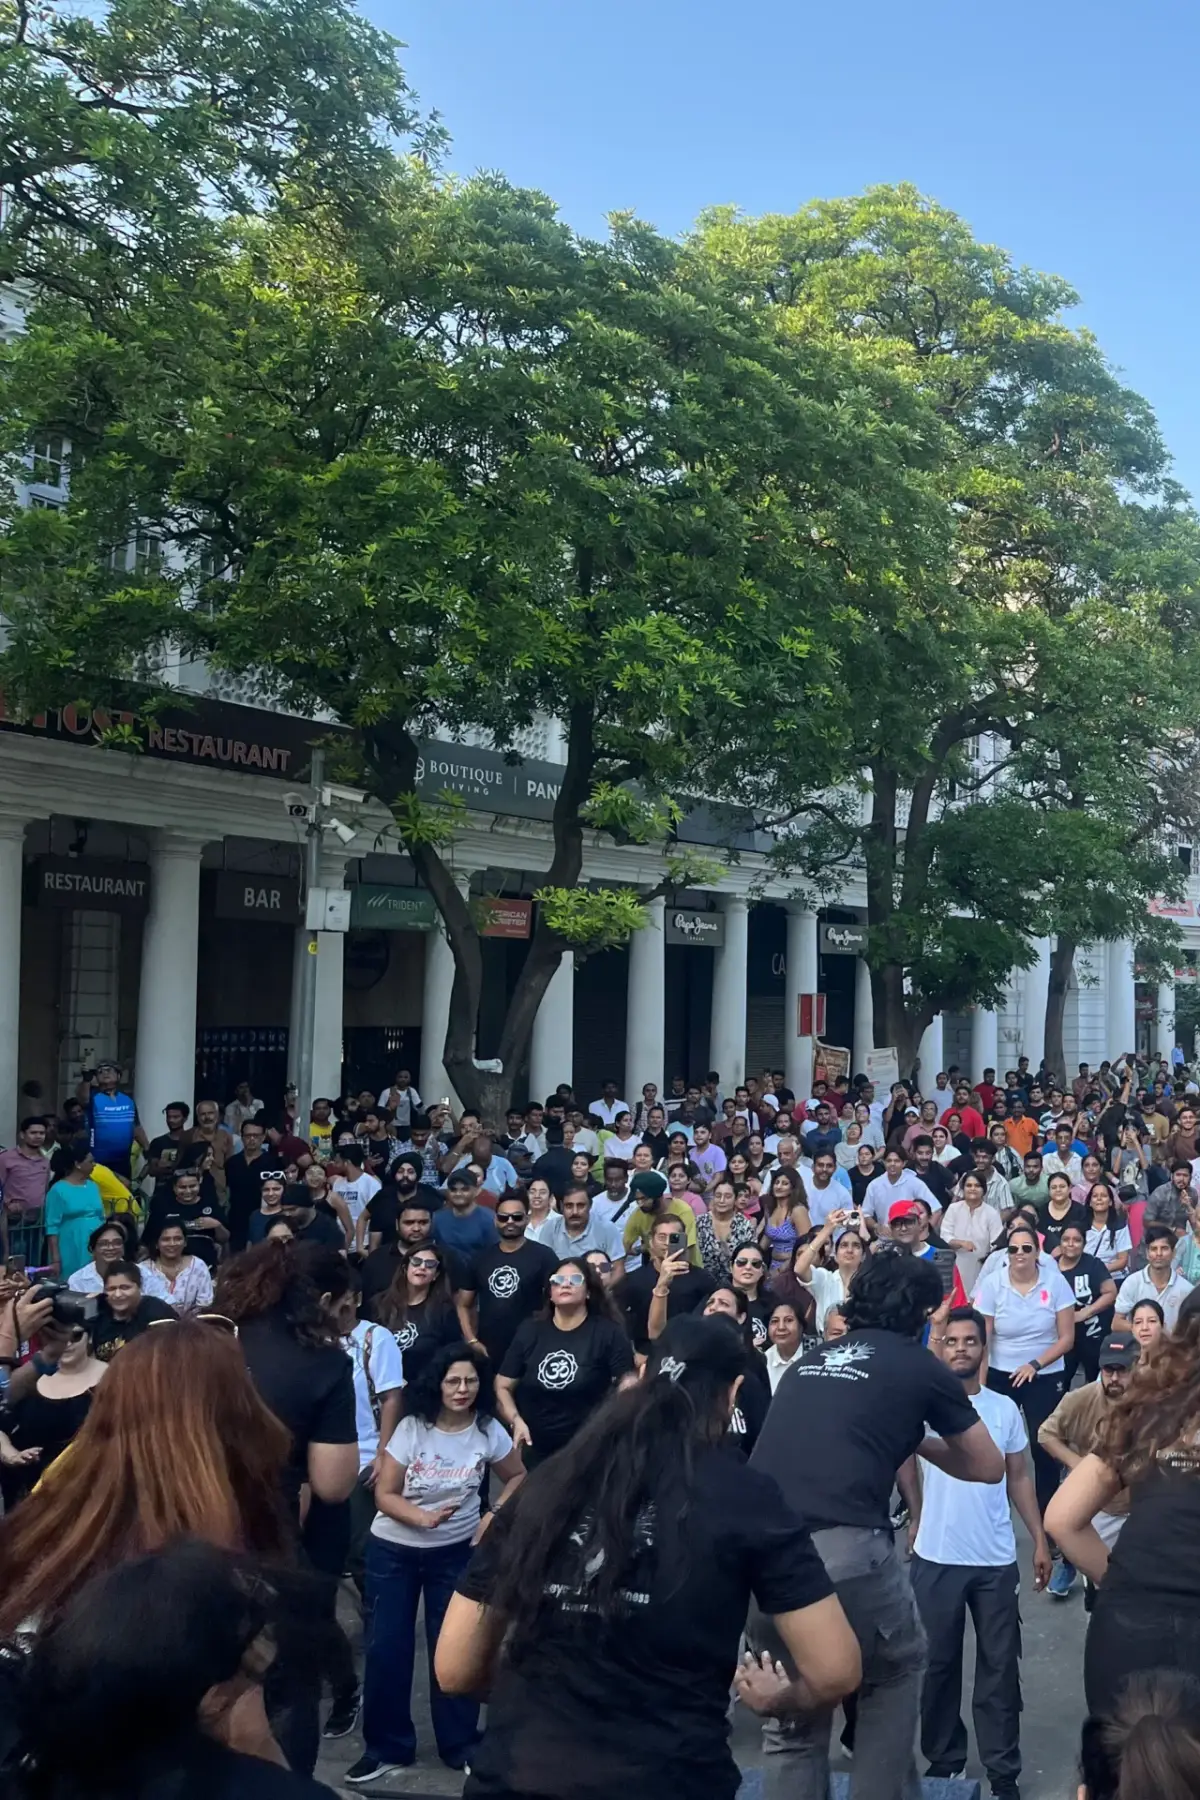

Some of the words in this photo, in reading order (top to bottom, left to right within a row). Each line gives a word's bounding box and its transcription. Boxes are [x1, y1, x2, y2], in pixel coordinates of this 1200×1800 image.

[149, 727, 291, 771] RESTAURANT
[430, 759, 503, 786] BOUTIQUE
[443, 781, 489, 796] LIVING
[527, 780, 563, 800] PAN
[44, 872, 146, 897] RESTAURANT
[244, 887, 281, 909] BAR
[388, 899, 425, 912] TRIDENT
[675, 913, 695, 934] Pepe
[694, 916, 718, 935] Jeans
